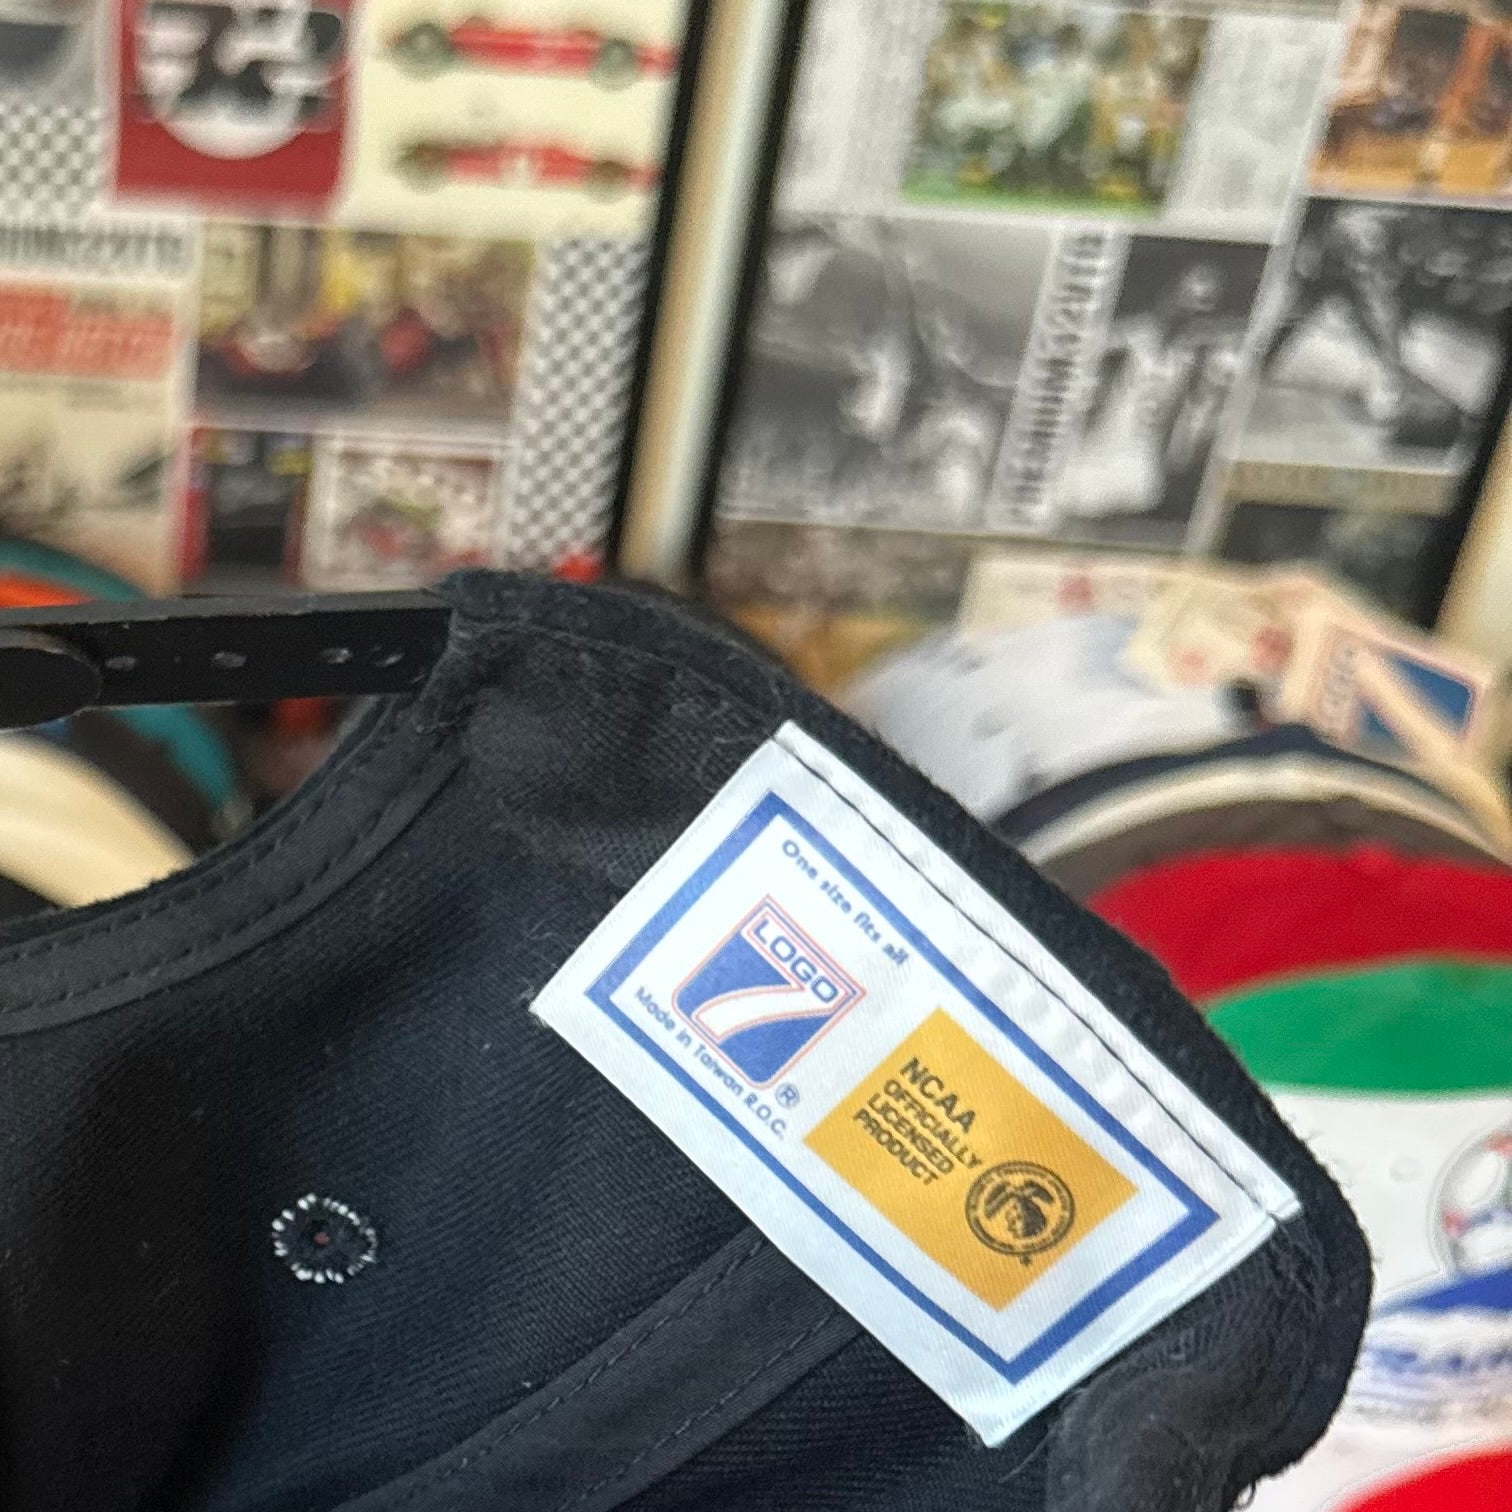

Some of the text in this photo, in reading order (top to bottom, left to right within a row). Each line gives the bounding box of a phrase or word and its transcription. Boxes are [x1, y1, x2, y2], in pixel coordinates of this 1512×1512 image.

[781, 838, 910, 967] One size fits all
[691, 902, 857, 1044] 7
[752, 917, 839, 1004] LOGO
[635, 986, 787, 1140] Made in Taiwan R.O.C.
[899, 1055, 977, 1135] NCAA
[853, 1107, 939, 1186] PRODUCT
[868, 1093, 955, 1175] LICENSED
[883, 1079, 984, 1170] OFFICIALLY
